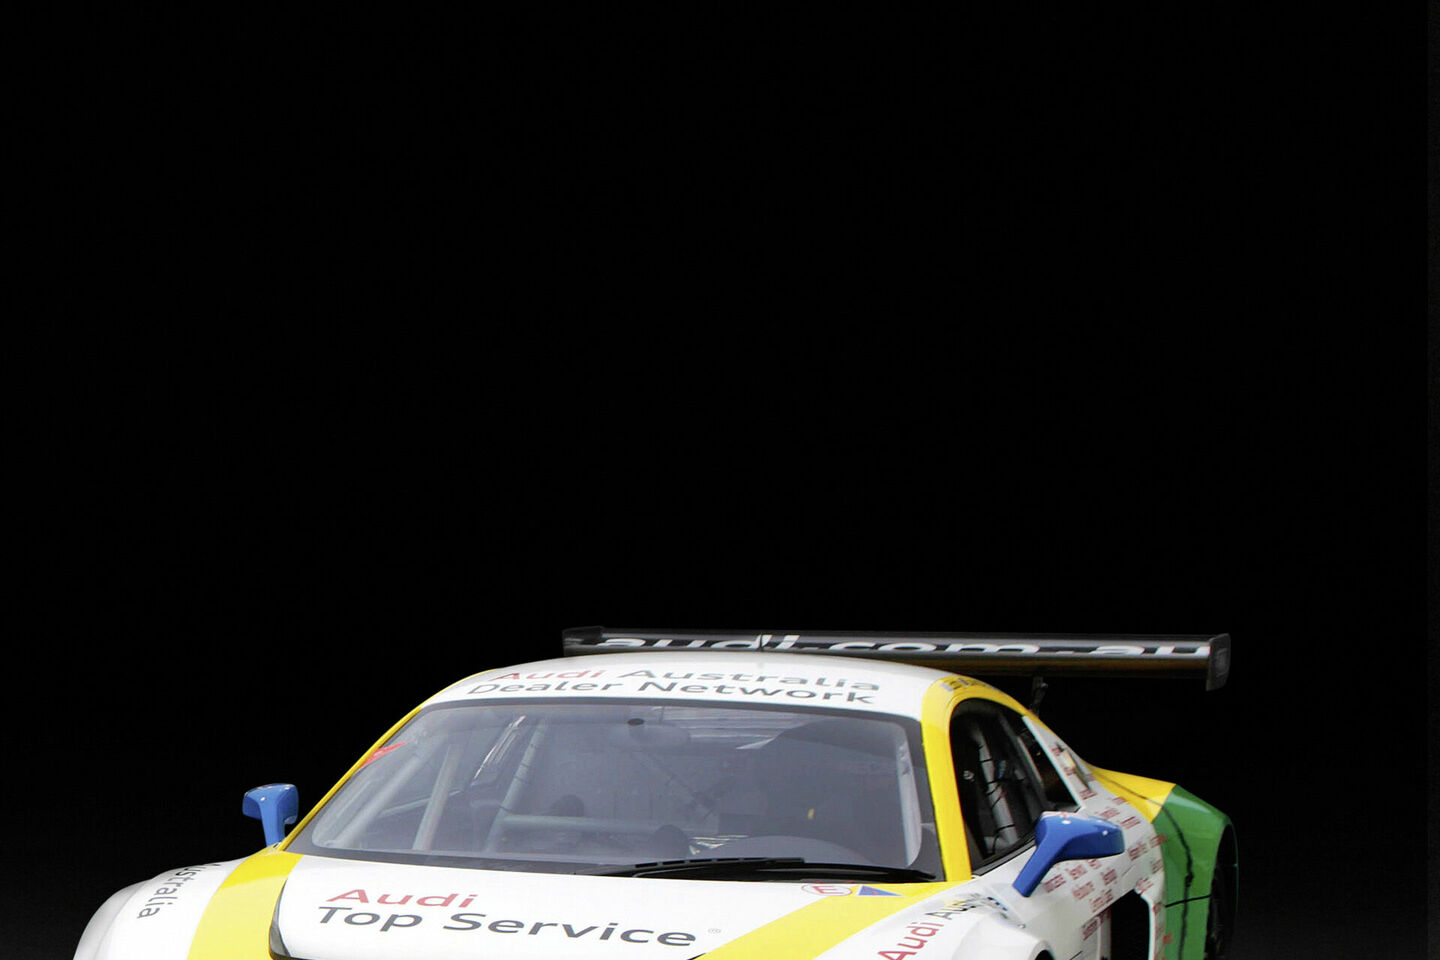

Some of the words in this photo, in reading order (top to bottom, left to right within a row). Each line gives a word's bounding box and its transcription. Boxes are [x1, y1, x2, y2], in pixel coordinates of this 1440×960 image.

[491, 669, 605, 682] Audi
[617, 669, 880, 691] Australia
[467, 681, 623, 695] Dealer
[638, 681, 877, 704] Network
[326, 889, 478, 908] Audi
[317, 906, 424, 933] Top
[442, 912, 697, 947] Service
